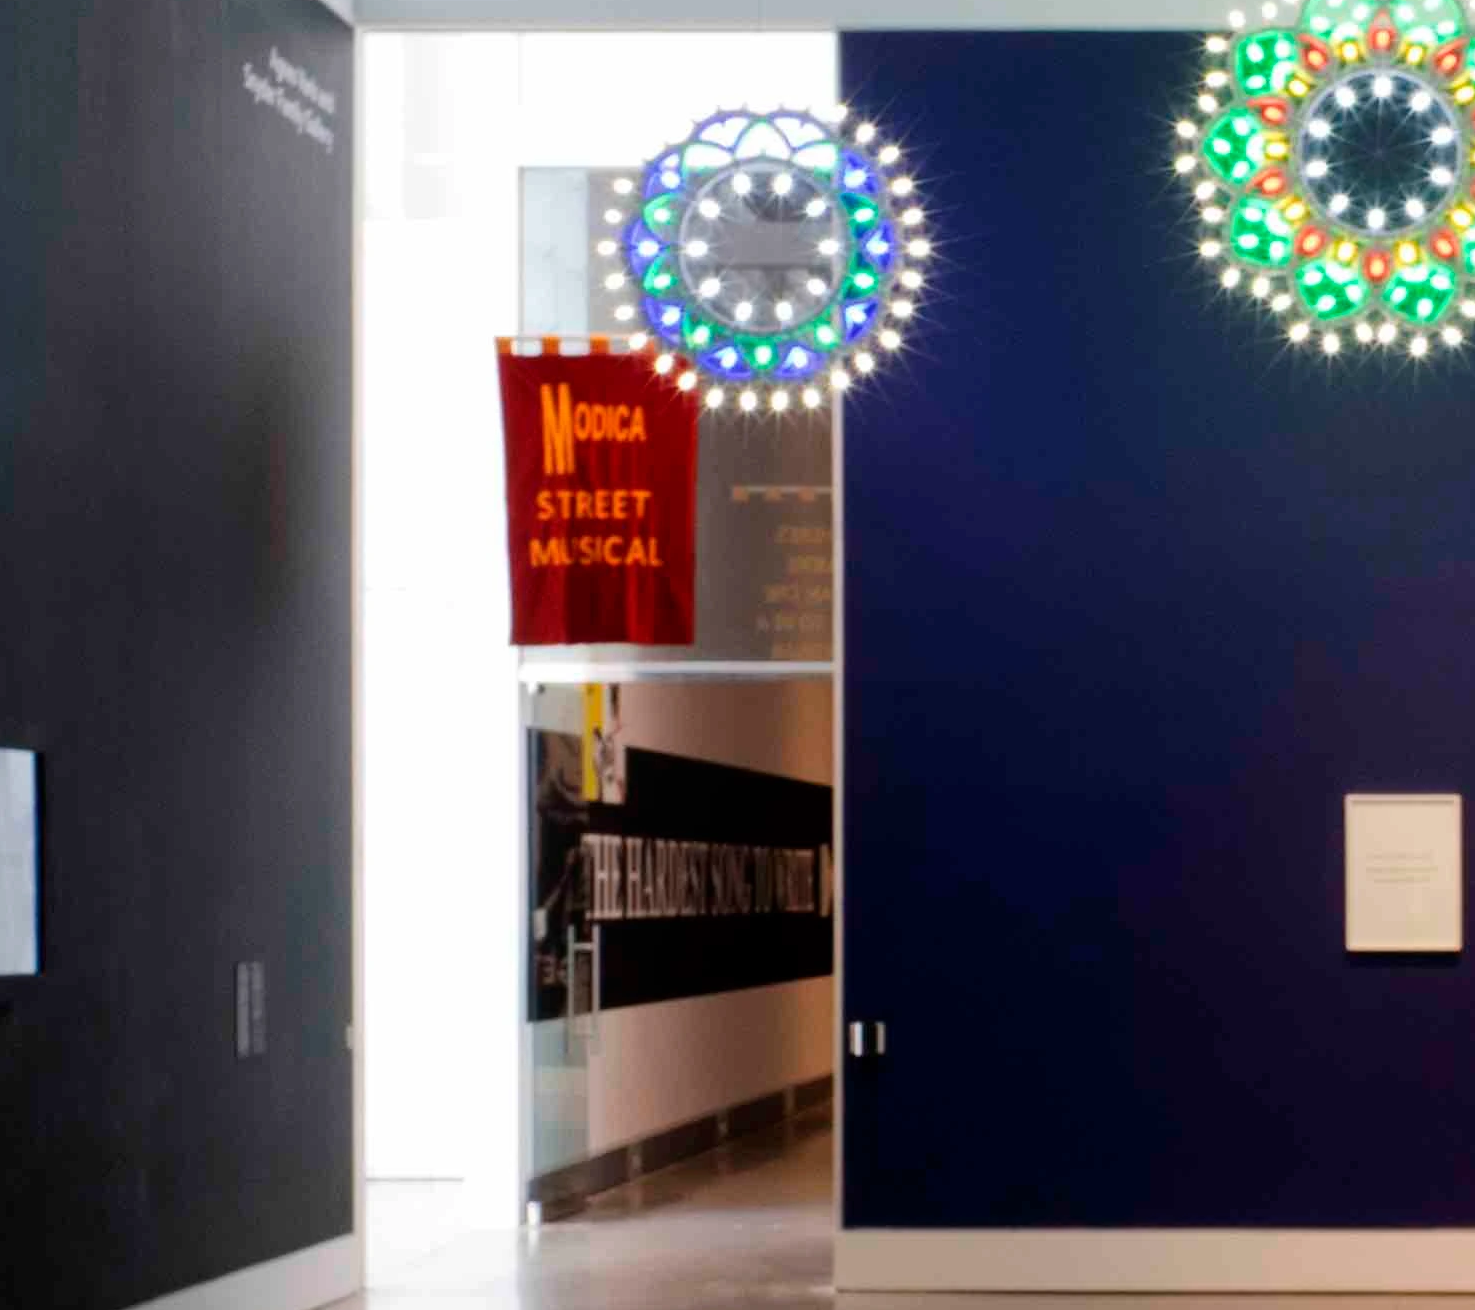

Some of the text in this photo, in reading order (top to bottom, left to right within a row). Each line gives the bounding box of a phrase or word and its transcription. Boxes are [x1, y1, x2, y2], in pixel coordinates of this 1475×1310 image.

[540, 382, 647, 475] MODICA
[536, 489, 652, 521] STREET
[529, 535, 664, 567] MUSICAL
[580, 832, 623, 920] THE
